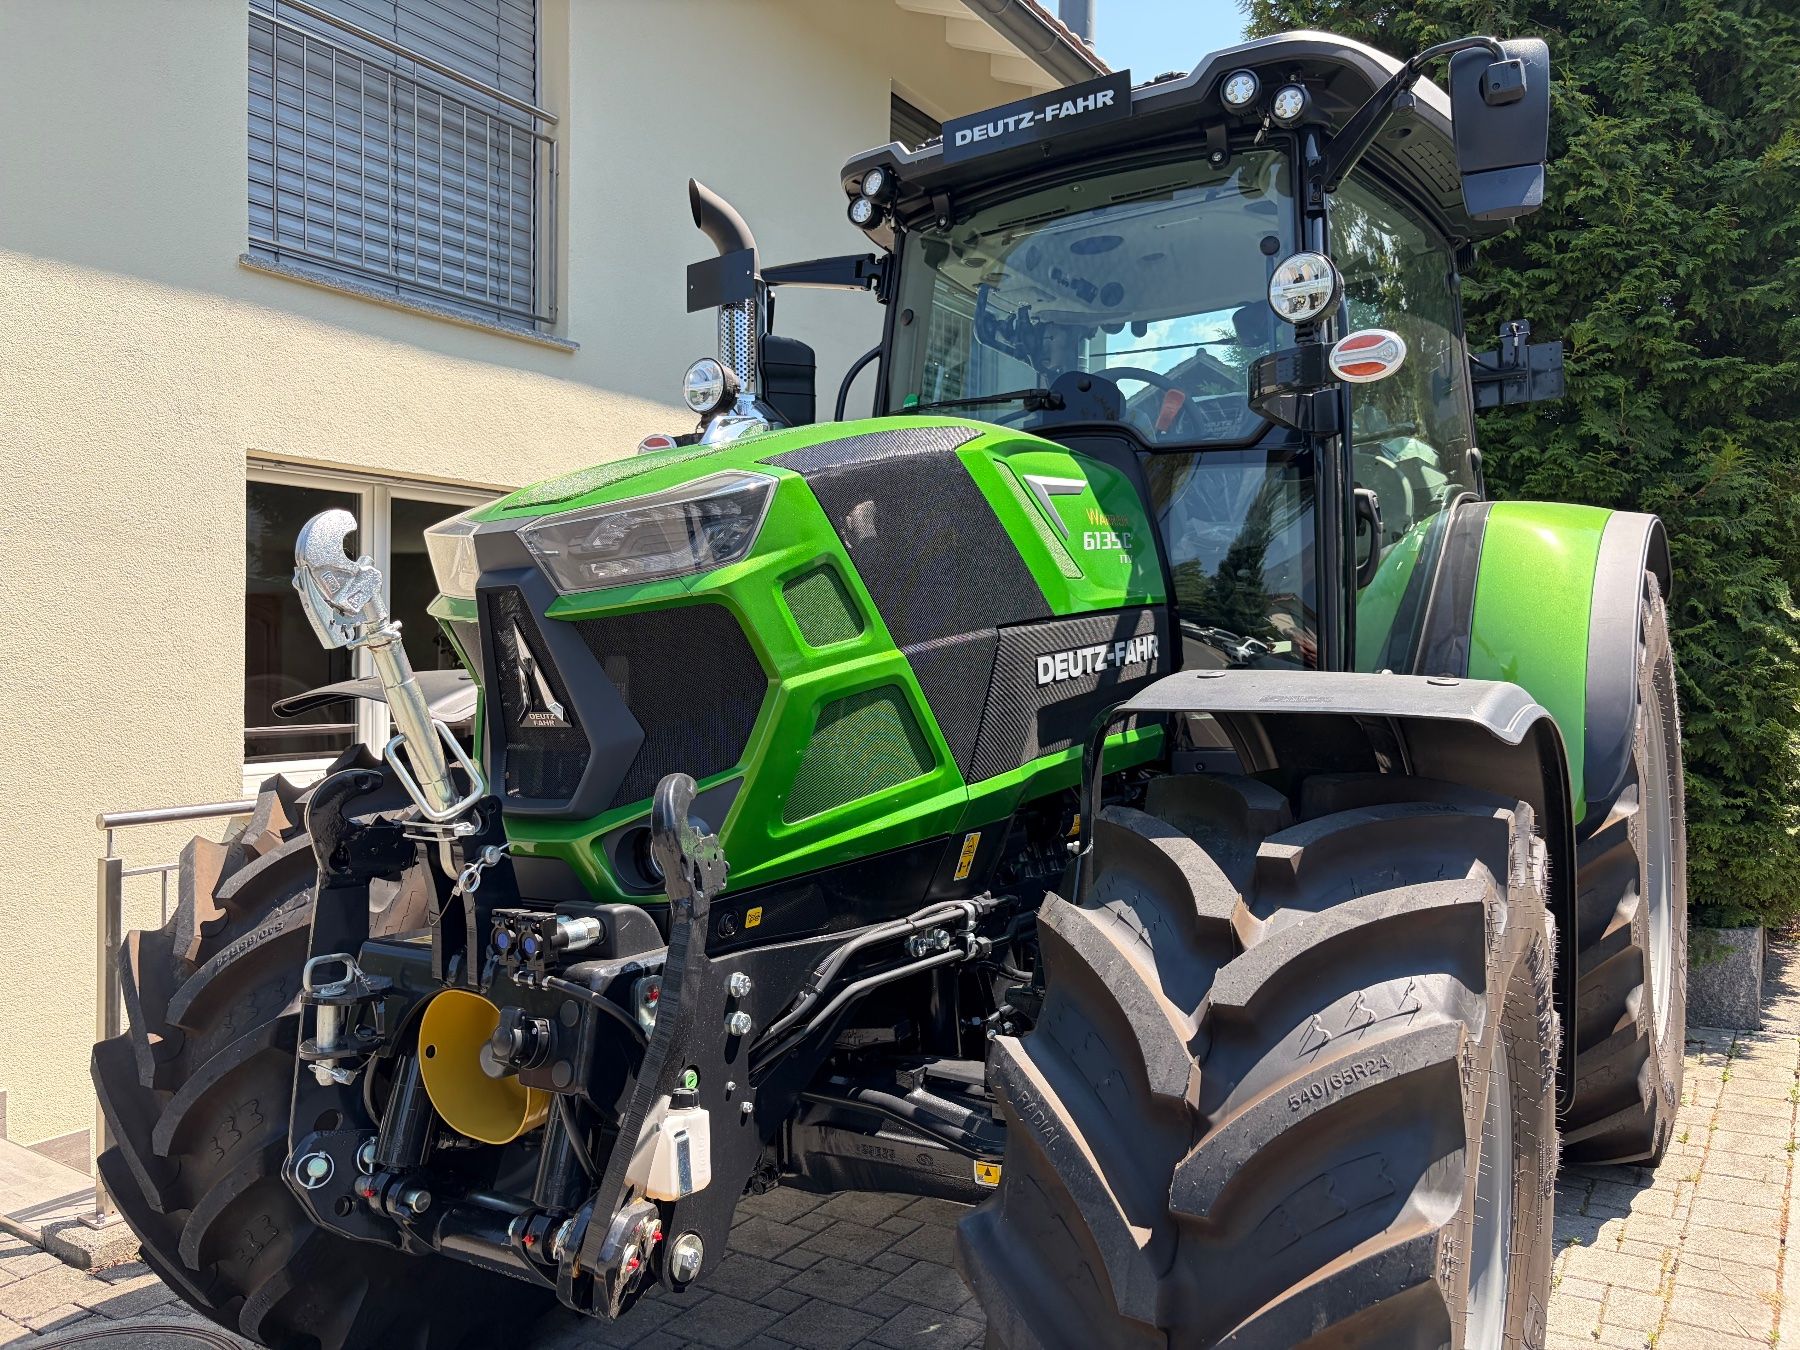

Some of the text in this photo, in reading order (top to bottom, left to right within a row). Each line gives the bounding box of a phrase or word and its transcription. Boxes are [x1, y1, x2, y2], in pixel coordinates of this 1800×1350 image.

[955, 89, 1115, 147] DEUTZ-FAHR
[1037, 634, 1159, 686] DEUTZ-FAHR
[533, 719, 556, 727] FAHR
[1287, 1054, 1393, 1113] 540/65R24
